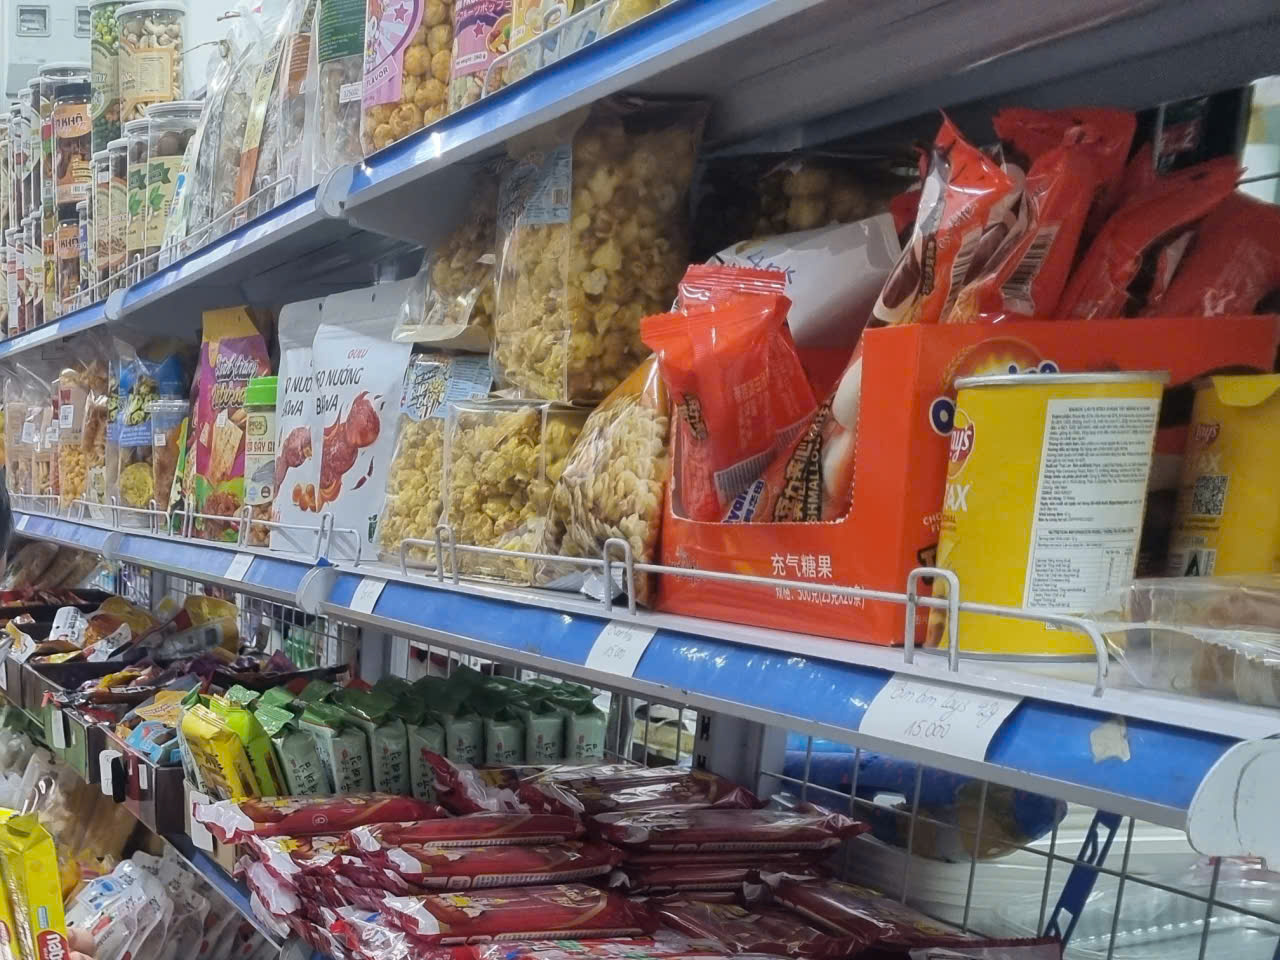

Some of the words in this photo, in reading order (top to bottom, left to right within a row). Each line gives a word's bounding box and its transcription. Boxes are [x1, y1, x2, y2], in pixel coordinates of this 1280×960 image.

[944, 484, 970, 512] AX
[770, 552, 833, 581] 充气糖果
